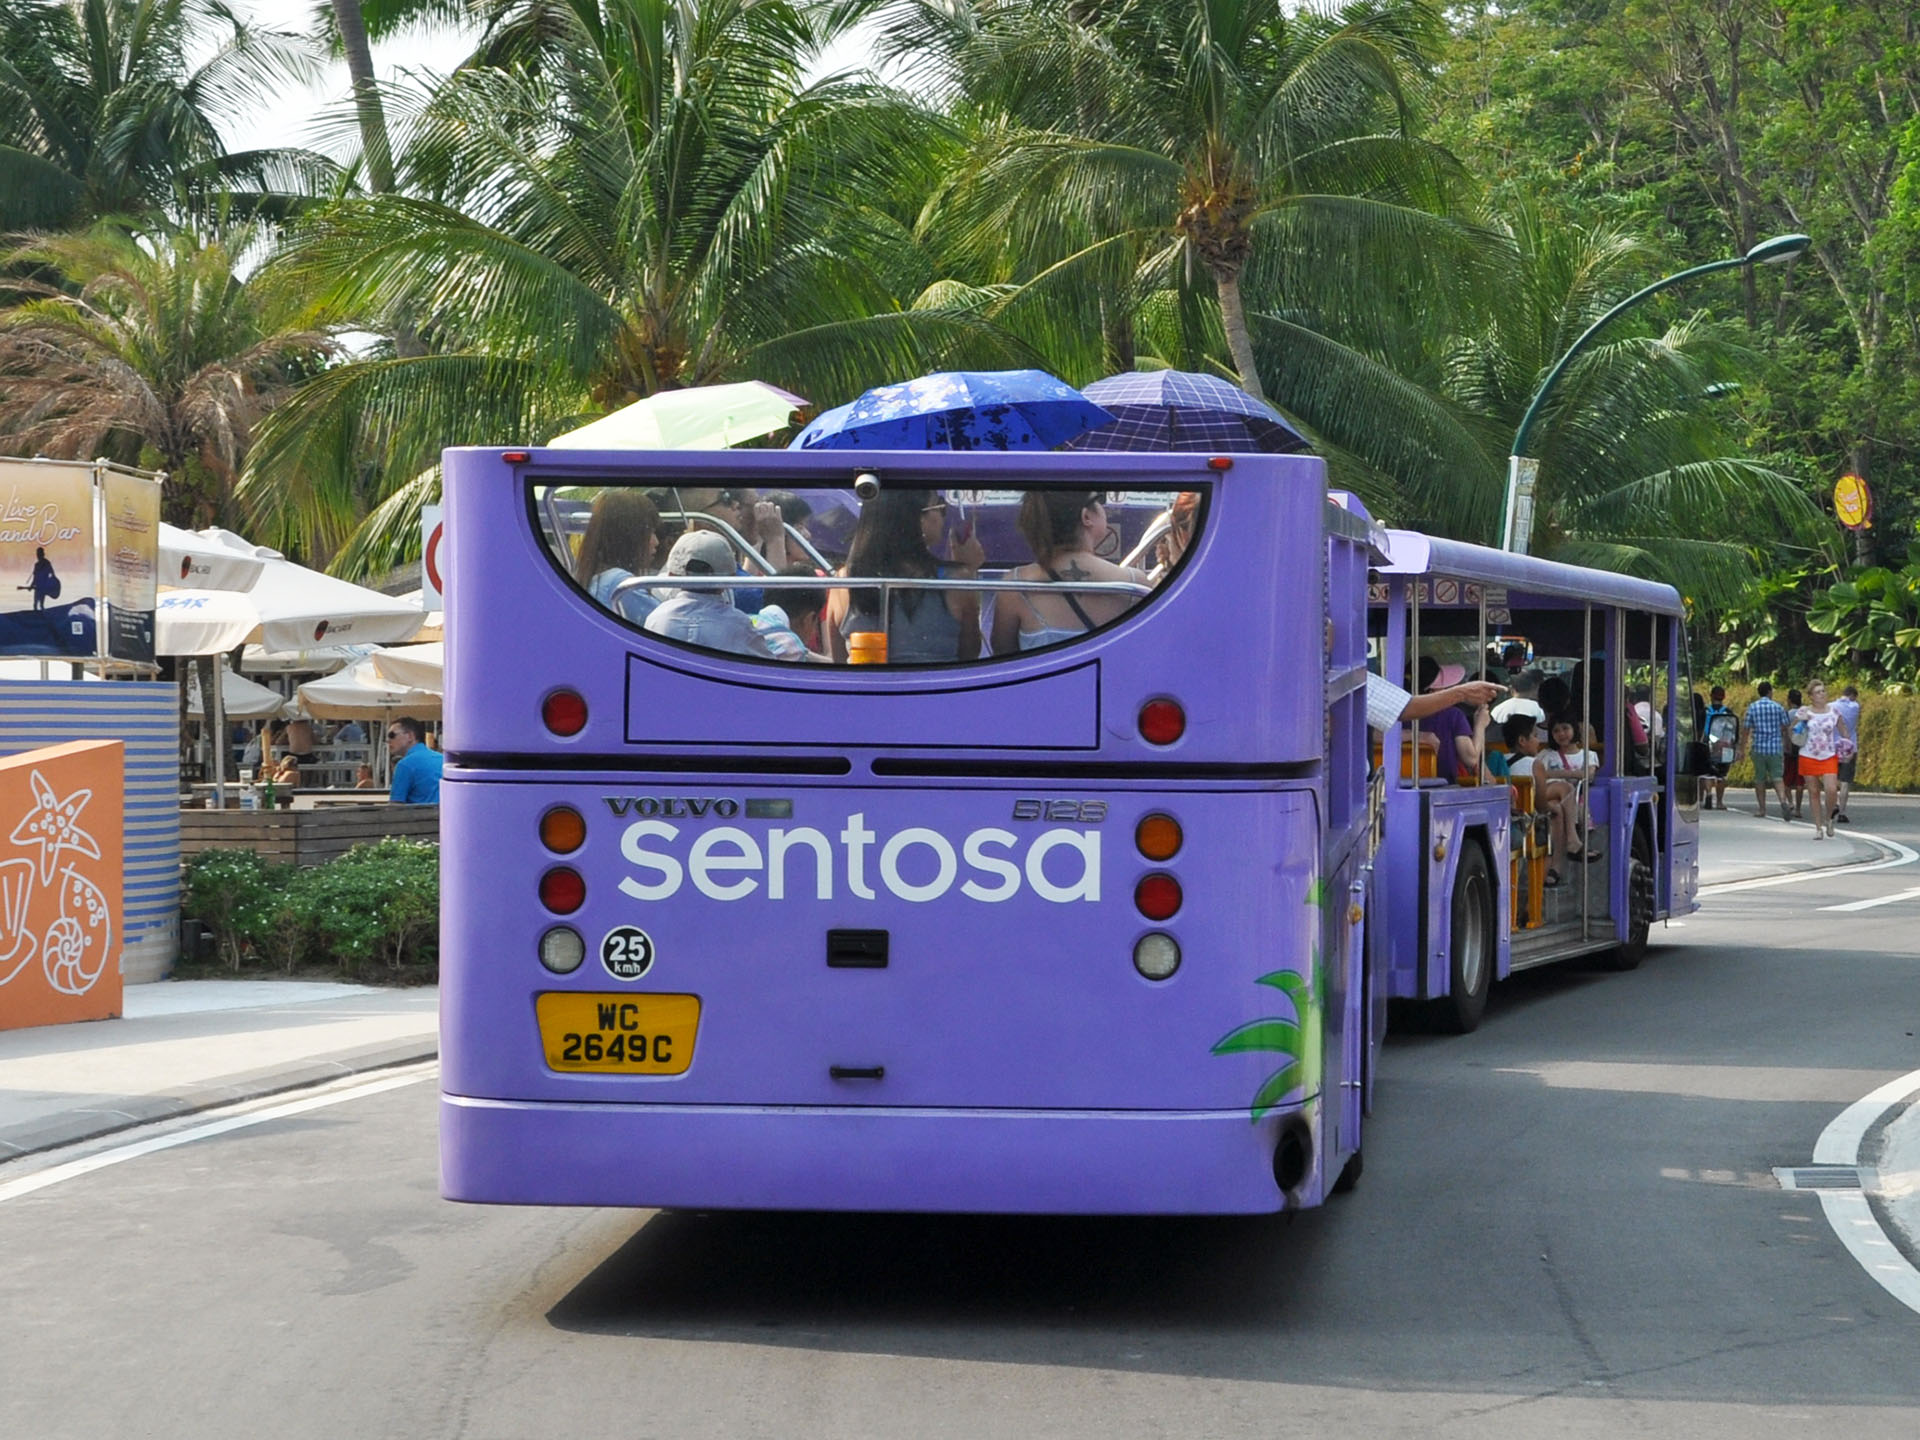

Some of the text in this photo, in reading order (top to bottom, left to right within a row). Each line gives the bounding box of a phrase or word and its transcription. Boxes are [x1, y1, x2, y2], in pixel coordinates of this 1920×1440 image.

[2, 484, 40, 523] Live
[37, 502, 81, 546] Bar
[602, 795, 739, 818] VOLVO
[609, 935, 646, 961] 25
[597, 1003, 640, 1031] WC
[562, 1032, 673, 1063] 2649C
